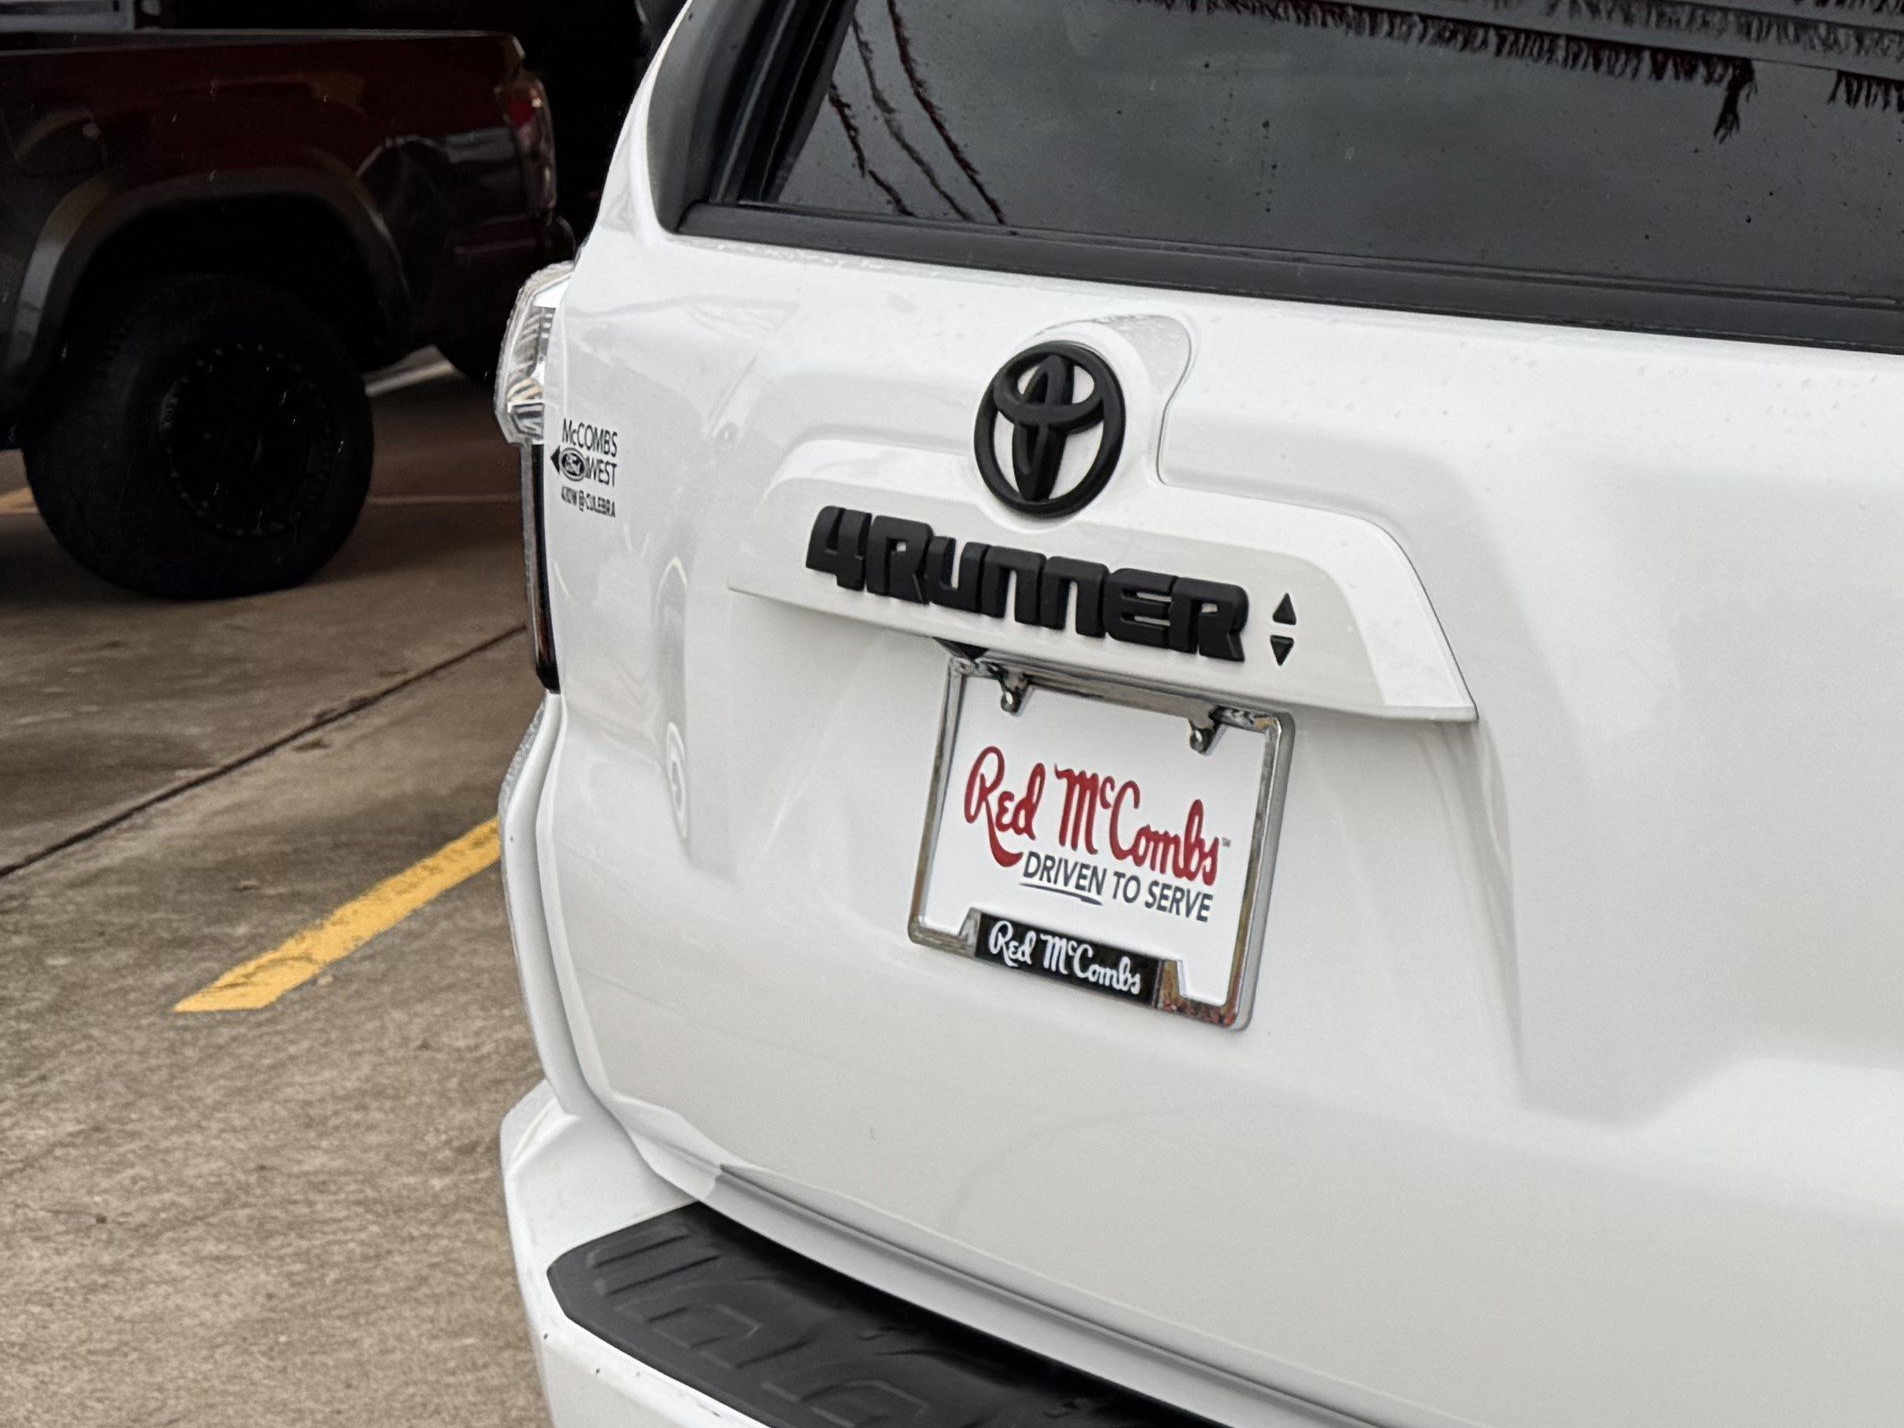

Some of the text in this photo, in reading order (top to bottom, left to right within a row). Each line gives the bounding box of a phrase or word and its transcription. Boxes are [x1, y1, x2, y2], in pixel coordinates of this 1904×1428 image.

[562, 418, 618, 458] McCOMBS
[585, 456, 618, 487] WEST
[806, 505, 1248, 662] 4RUNNER
[965, 746, 1046, 867] Red
[1054, 764, 1220, 885] McCombs
[1023, 851, 1214, 922] DRIVEN TO SERVE
[988, 921, 1142, 995] Red McCombs
